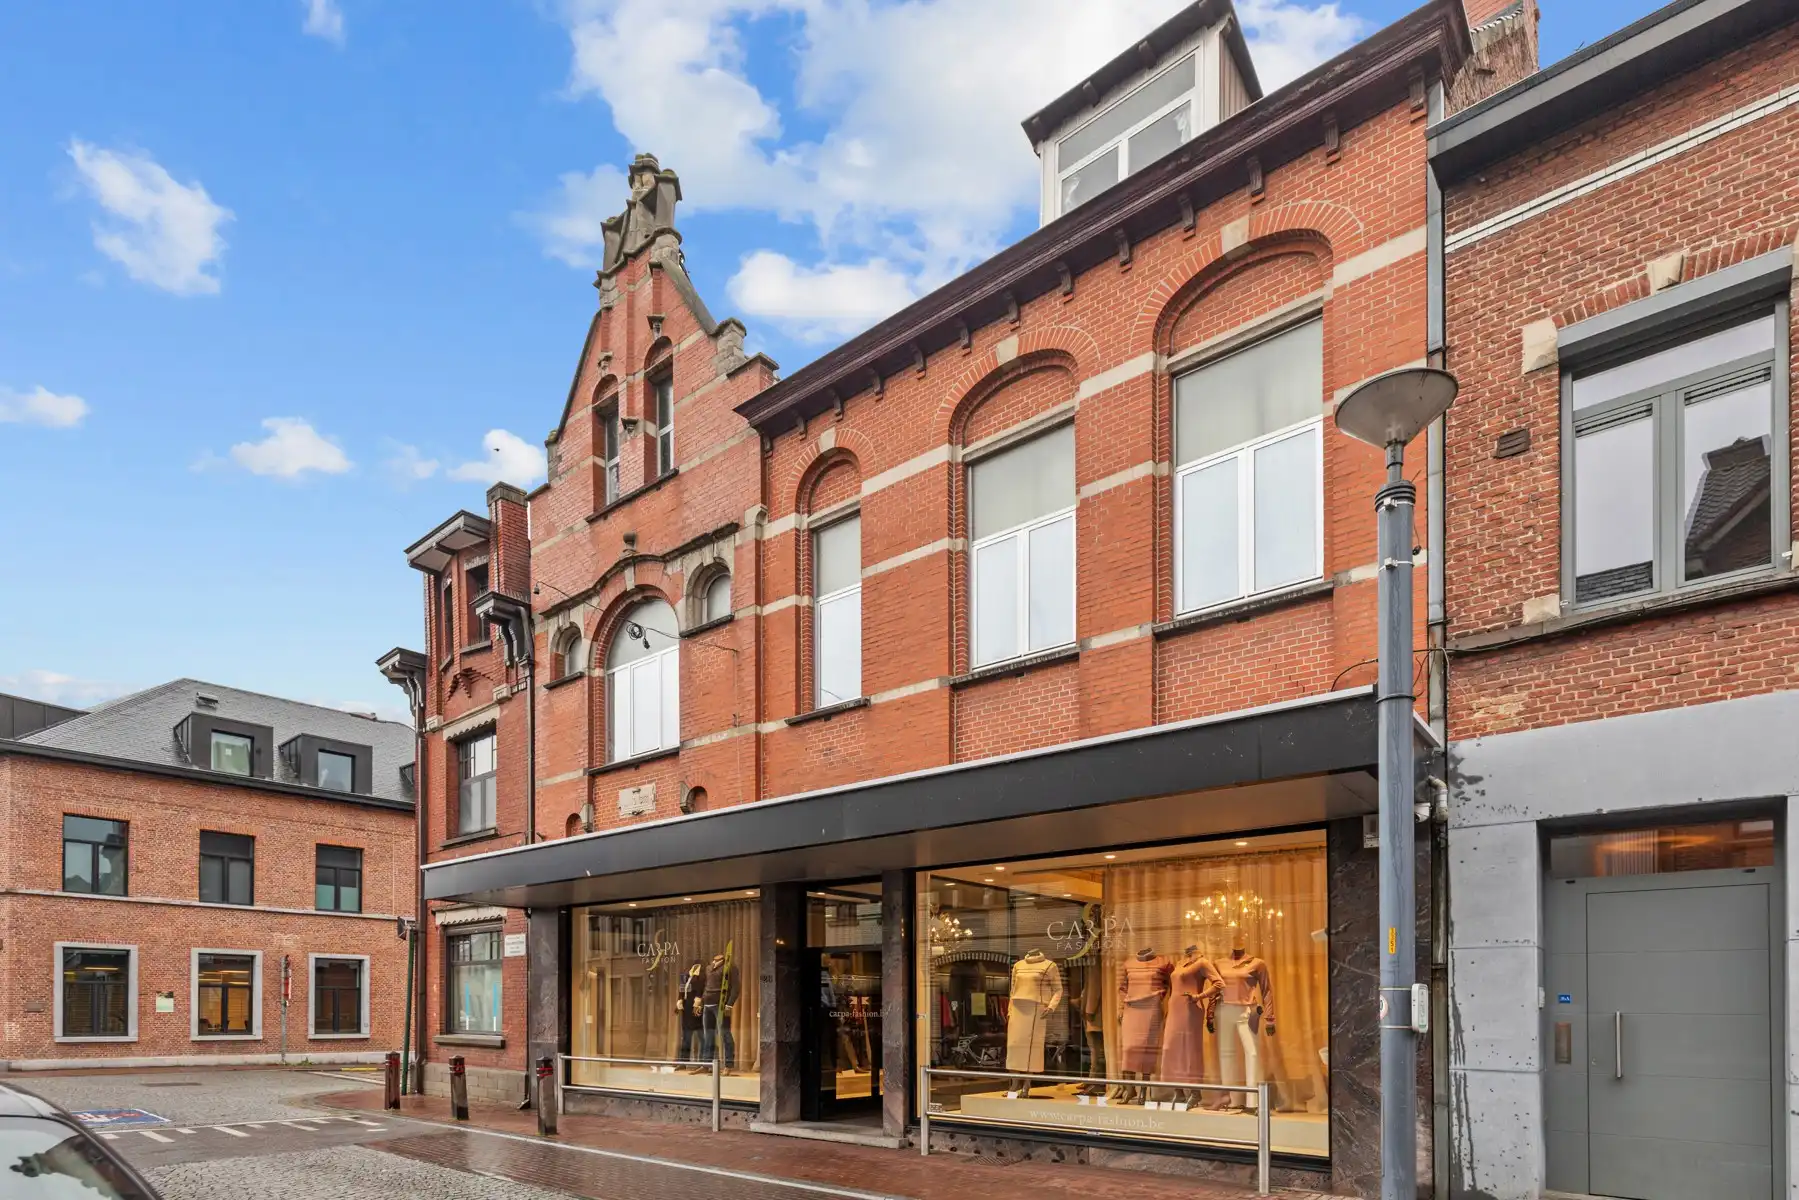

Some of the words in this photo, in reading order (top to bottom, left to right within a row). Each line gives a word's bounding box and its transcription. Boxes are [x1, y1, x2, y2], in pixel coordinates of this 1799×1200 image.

[1046, 917, 1136, 941] CARPA
[641, 956, 676, 965] FASION
[829, 1008, 884, 1021] carpa-fashion.b
